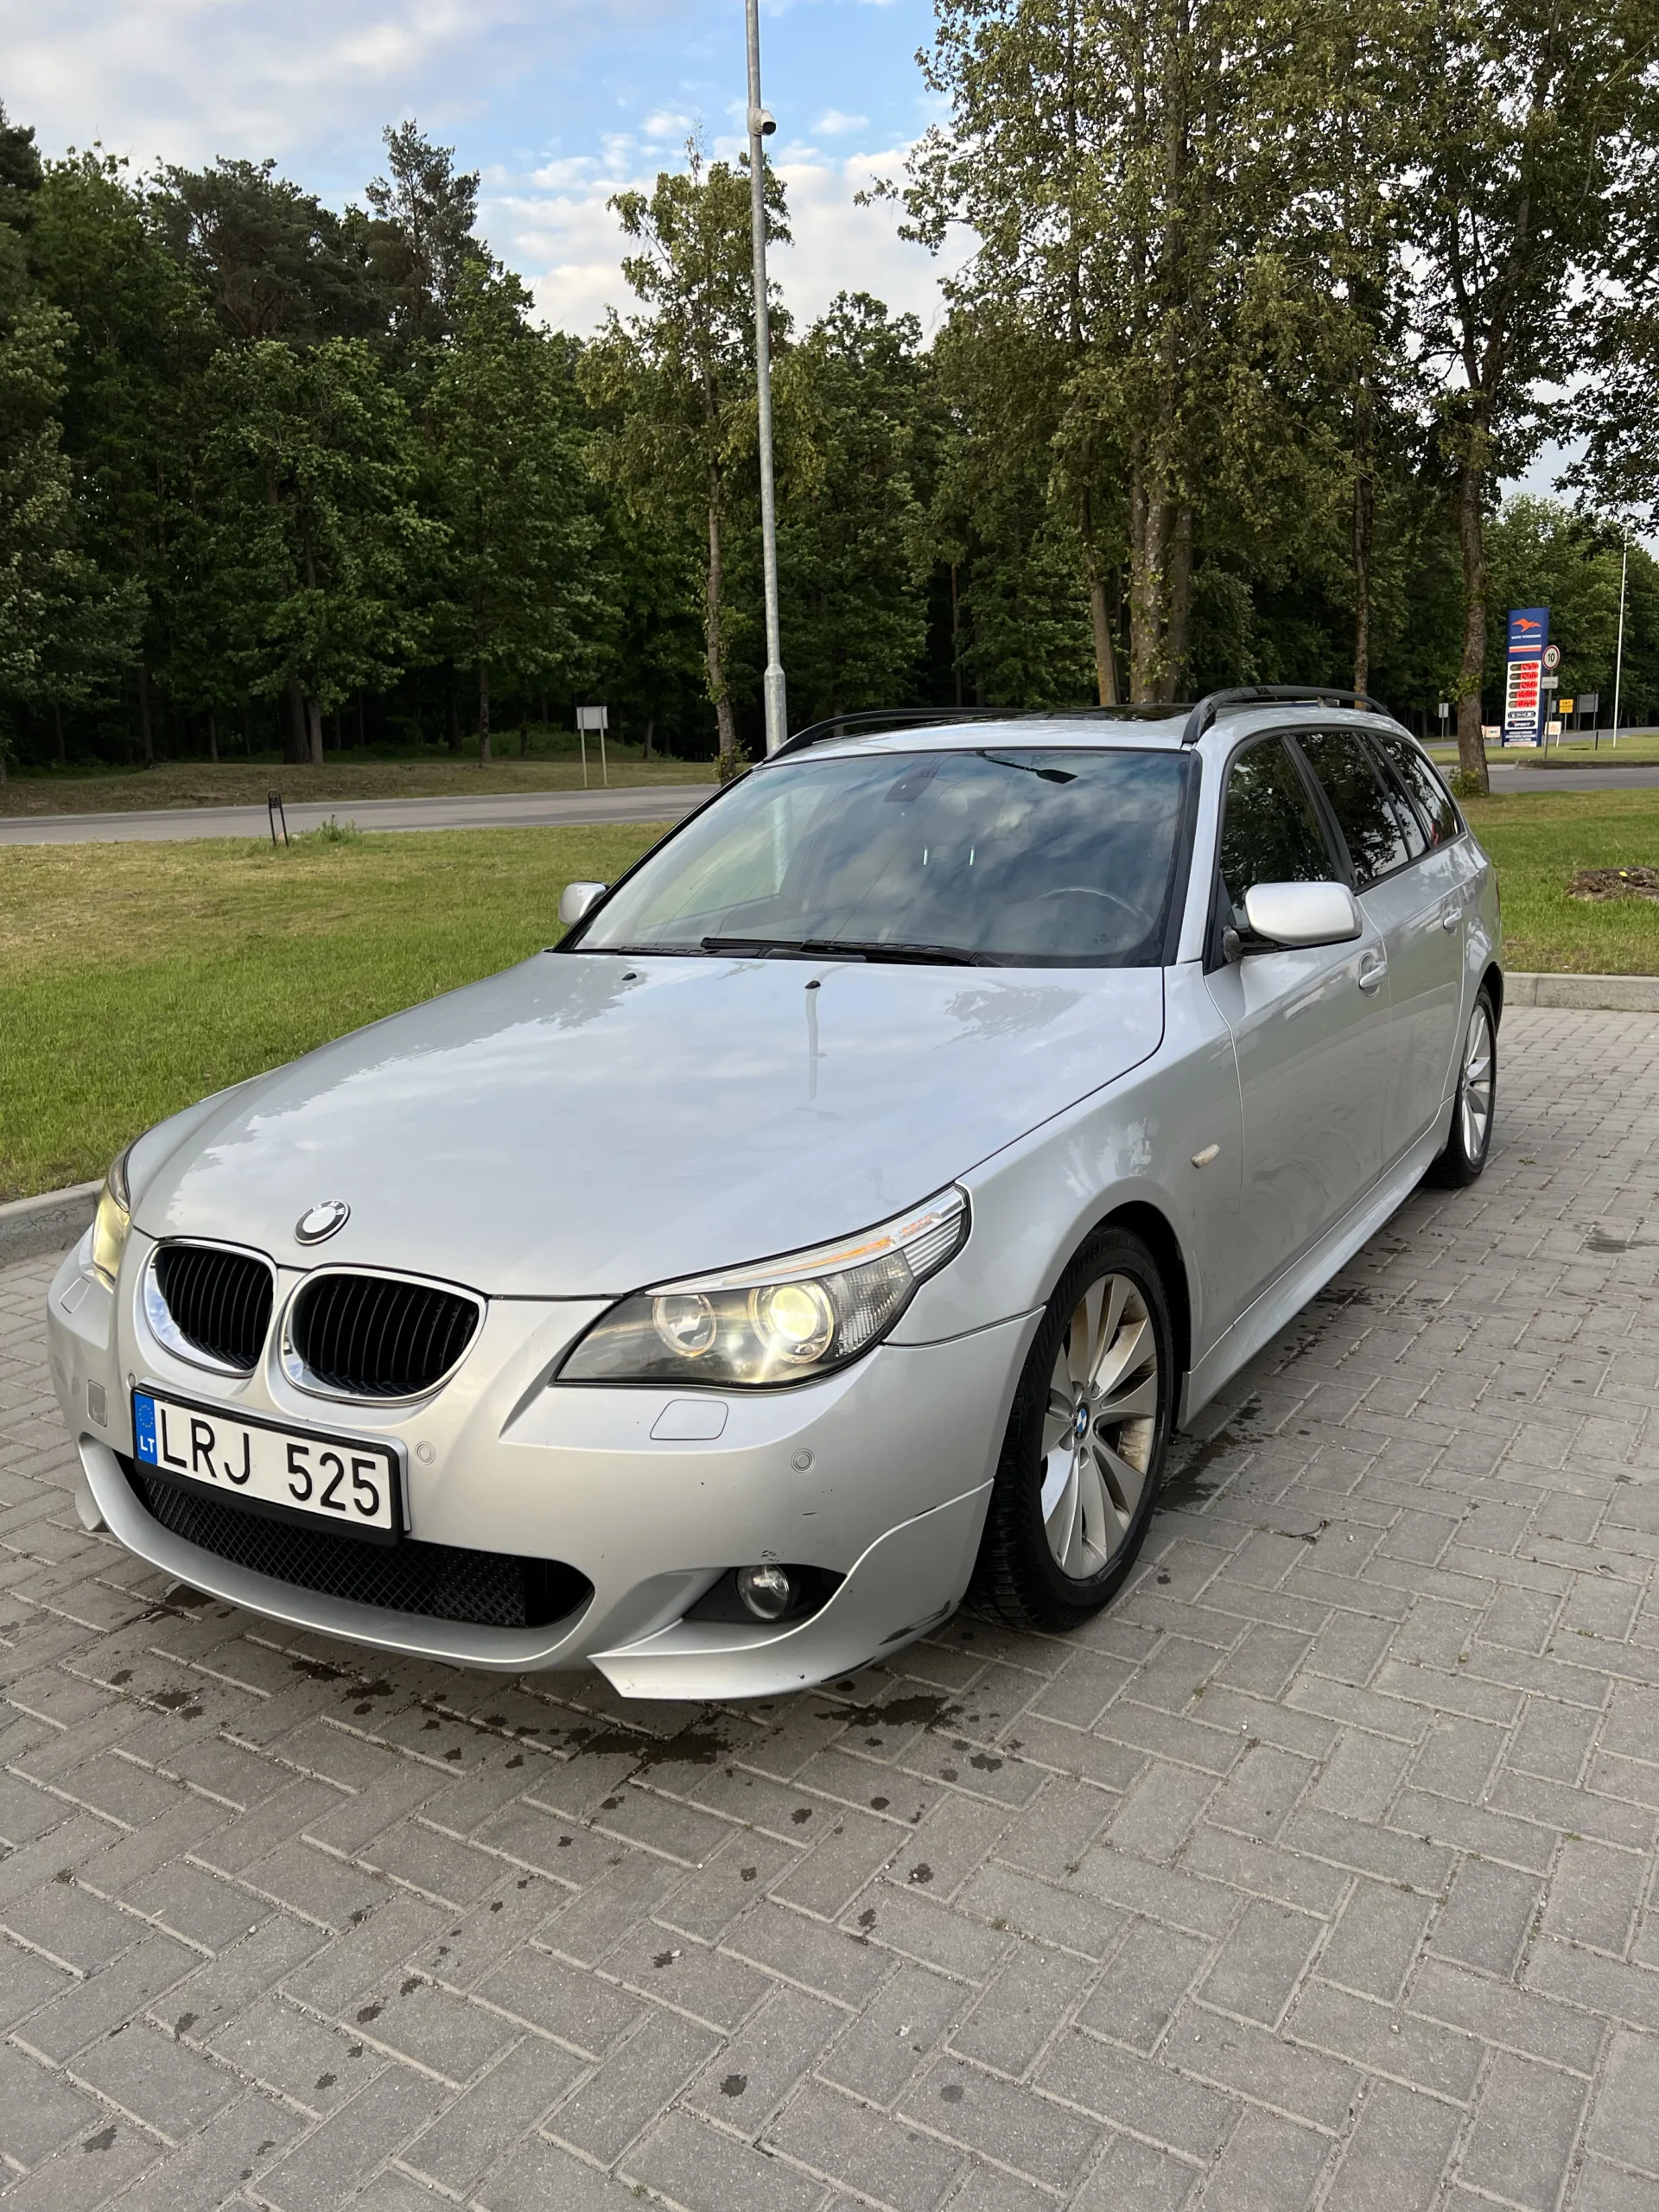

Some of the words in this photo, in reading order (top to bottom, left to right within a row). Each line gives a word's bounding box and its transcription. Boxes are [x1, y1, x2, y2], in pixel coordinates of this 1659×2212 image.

[1548, 652, 1555, 663] 10
[139, 1434, 156, 1453] LT
[161, 1408, 251, 1484] LRJ
[286, 1443, 379, 1516] 525
